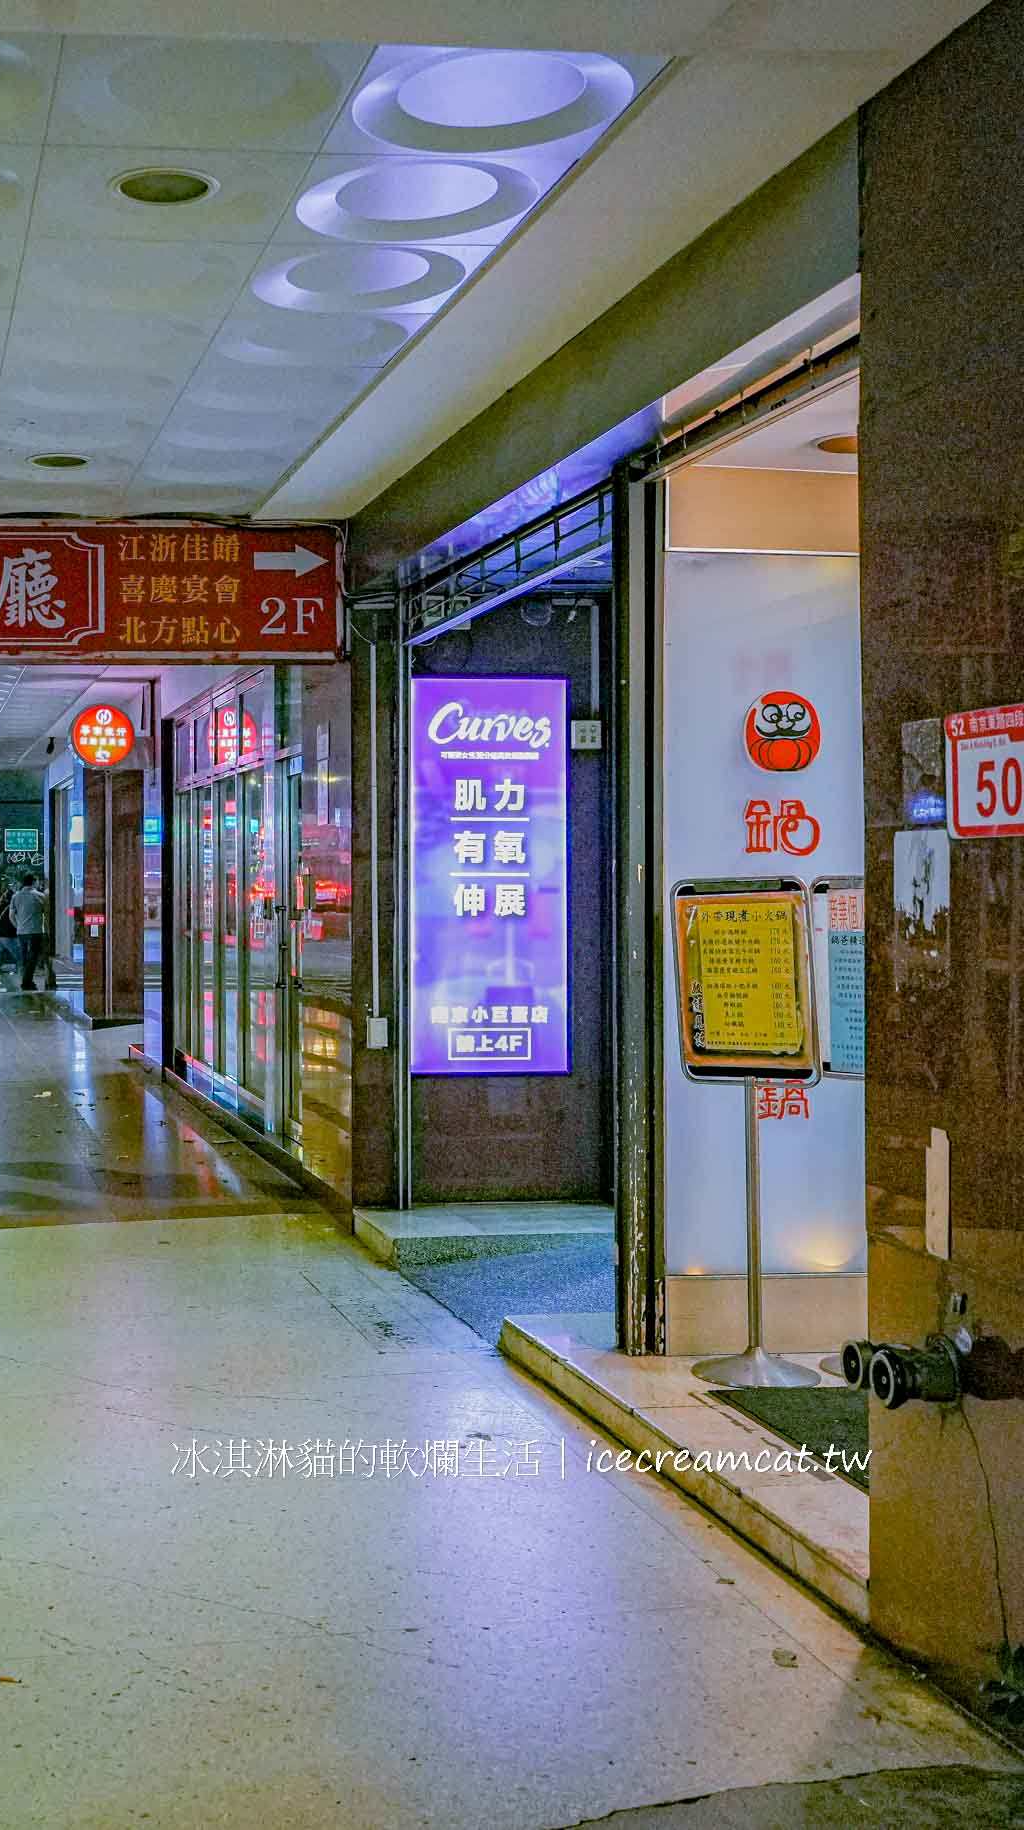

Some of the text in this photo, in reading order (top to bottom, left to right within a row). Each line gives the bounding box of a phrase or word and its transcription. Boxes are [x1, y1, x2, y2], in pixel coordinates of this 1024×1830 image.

[118, 533, 241, 564] 江浙佳餚
[118, 573, 241, 605] 喜慶宴會
[118, 614, 241, 646] 北方點心
[259, 597, 324, 636] 2F
[427, 702, 552, 749] Curves
[454, 778, 525, 811] 肌力
[453, 830, 526, 864] 有氧
[453, 883, 526, 917] 伸展
